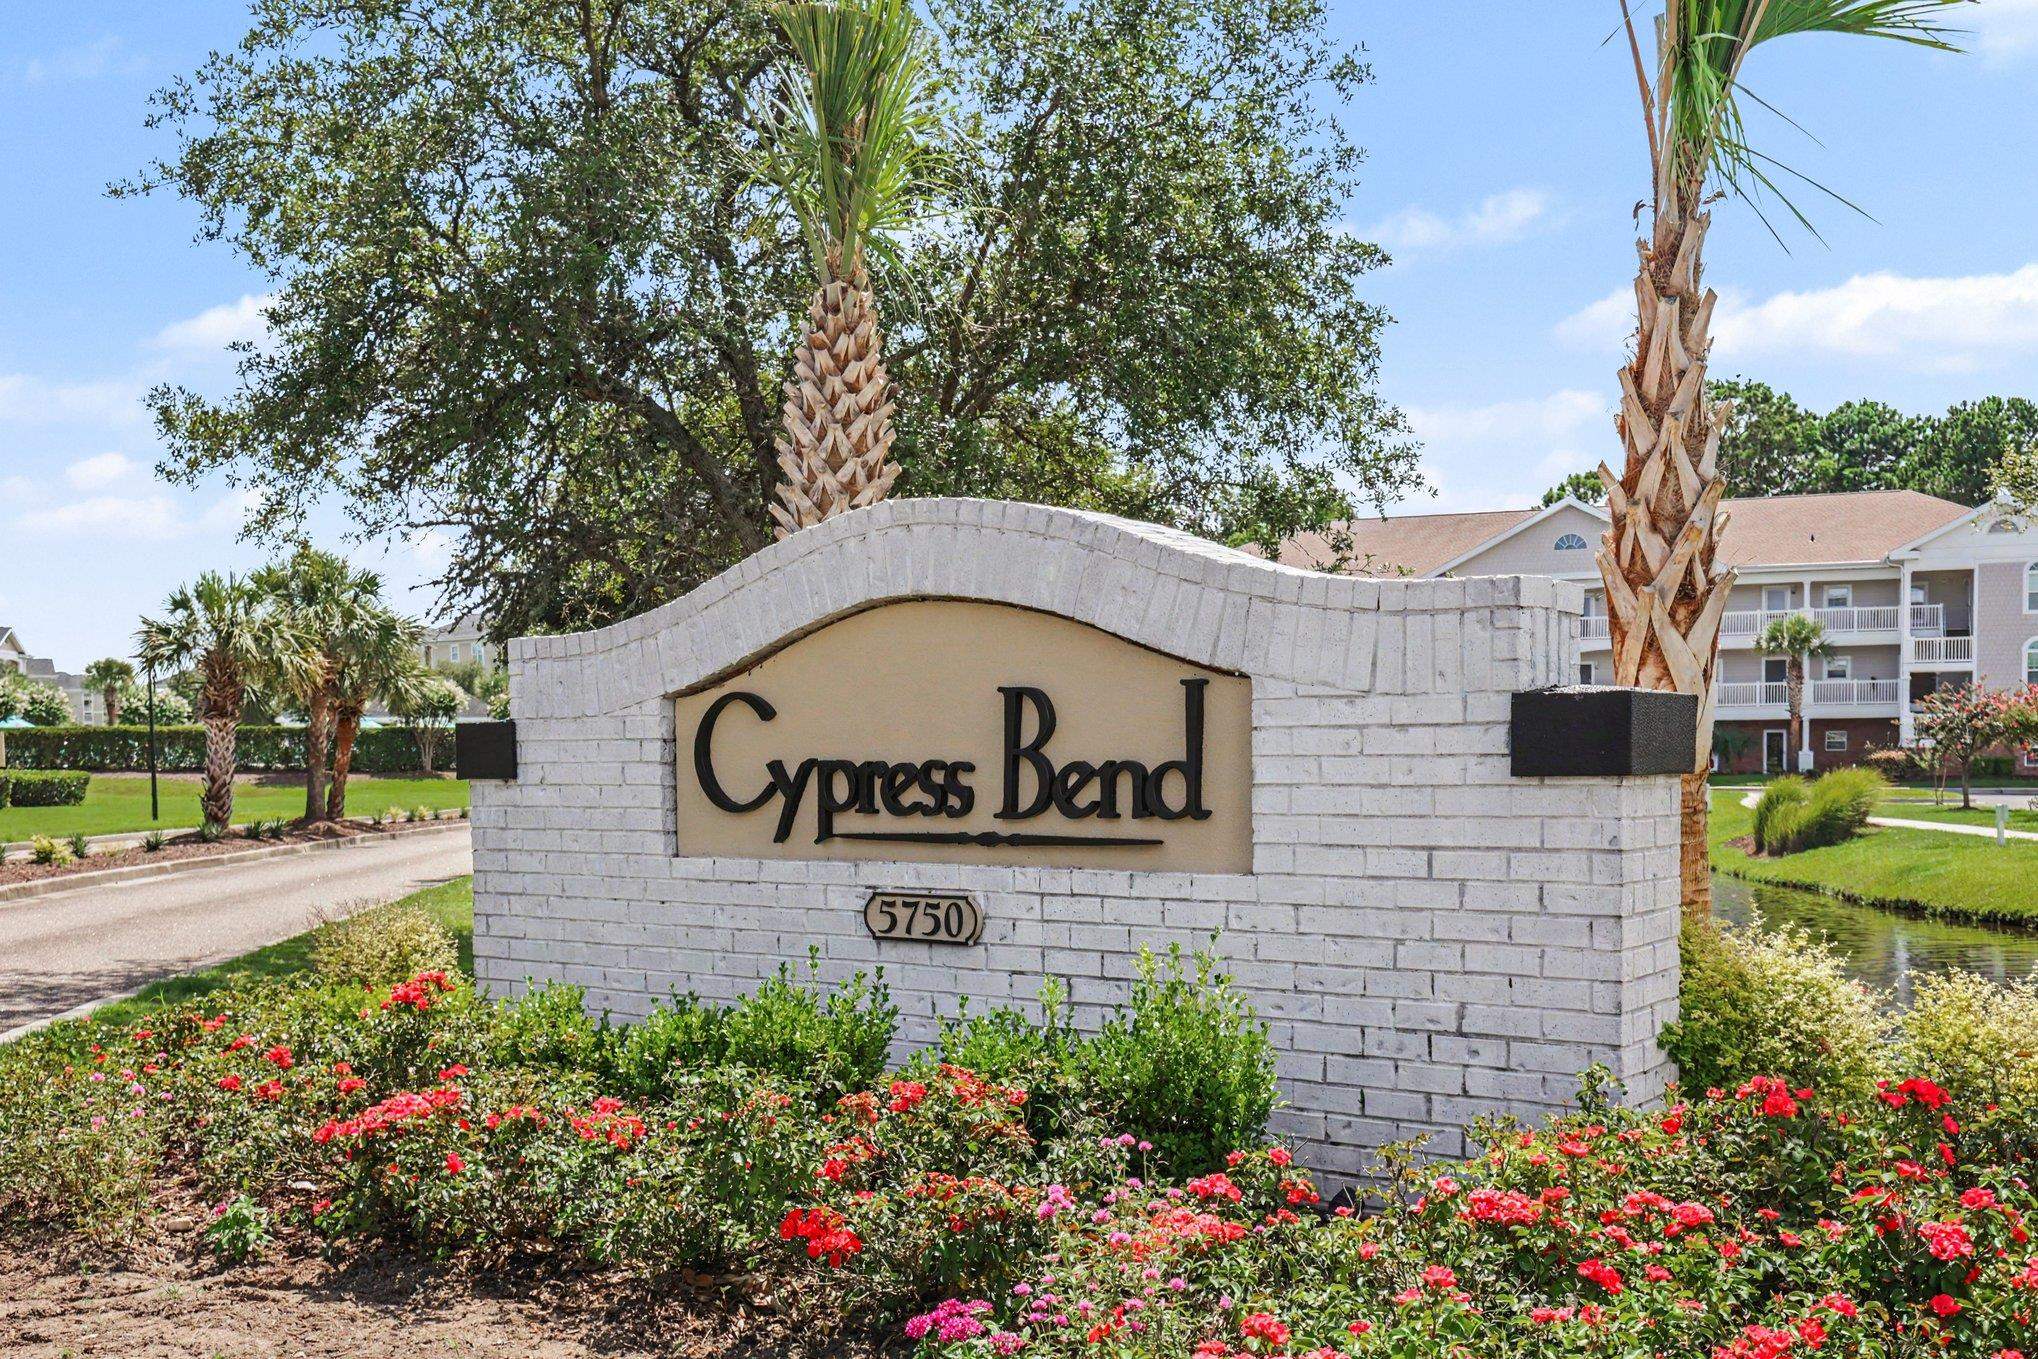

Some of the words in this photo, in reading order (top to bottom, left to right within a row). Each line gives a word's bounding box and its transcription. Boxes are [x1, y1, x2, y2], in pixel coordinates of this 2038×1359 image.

[694, 691, 976, 844] Cypress
[993, 678, 1213, 821] Bend
[877, 899, 964, 938] 5750
